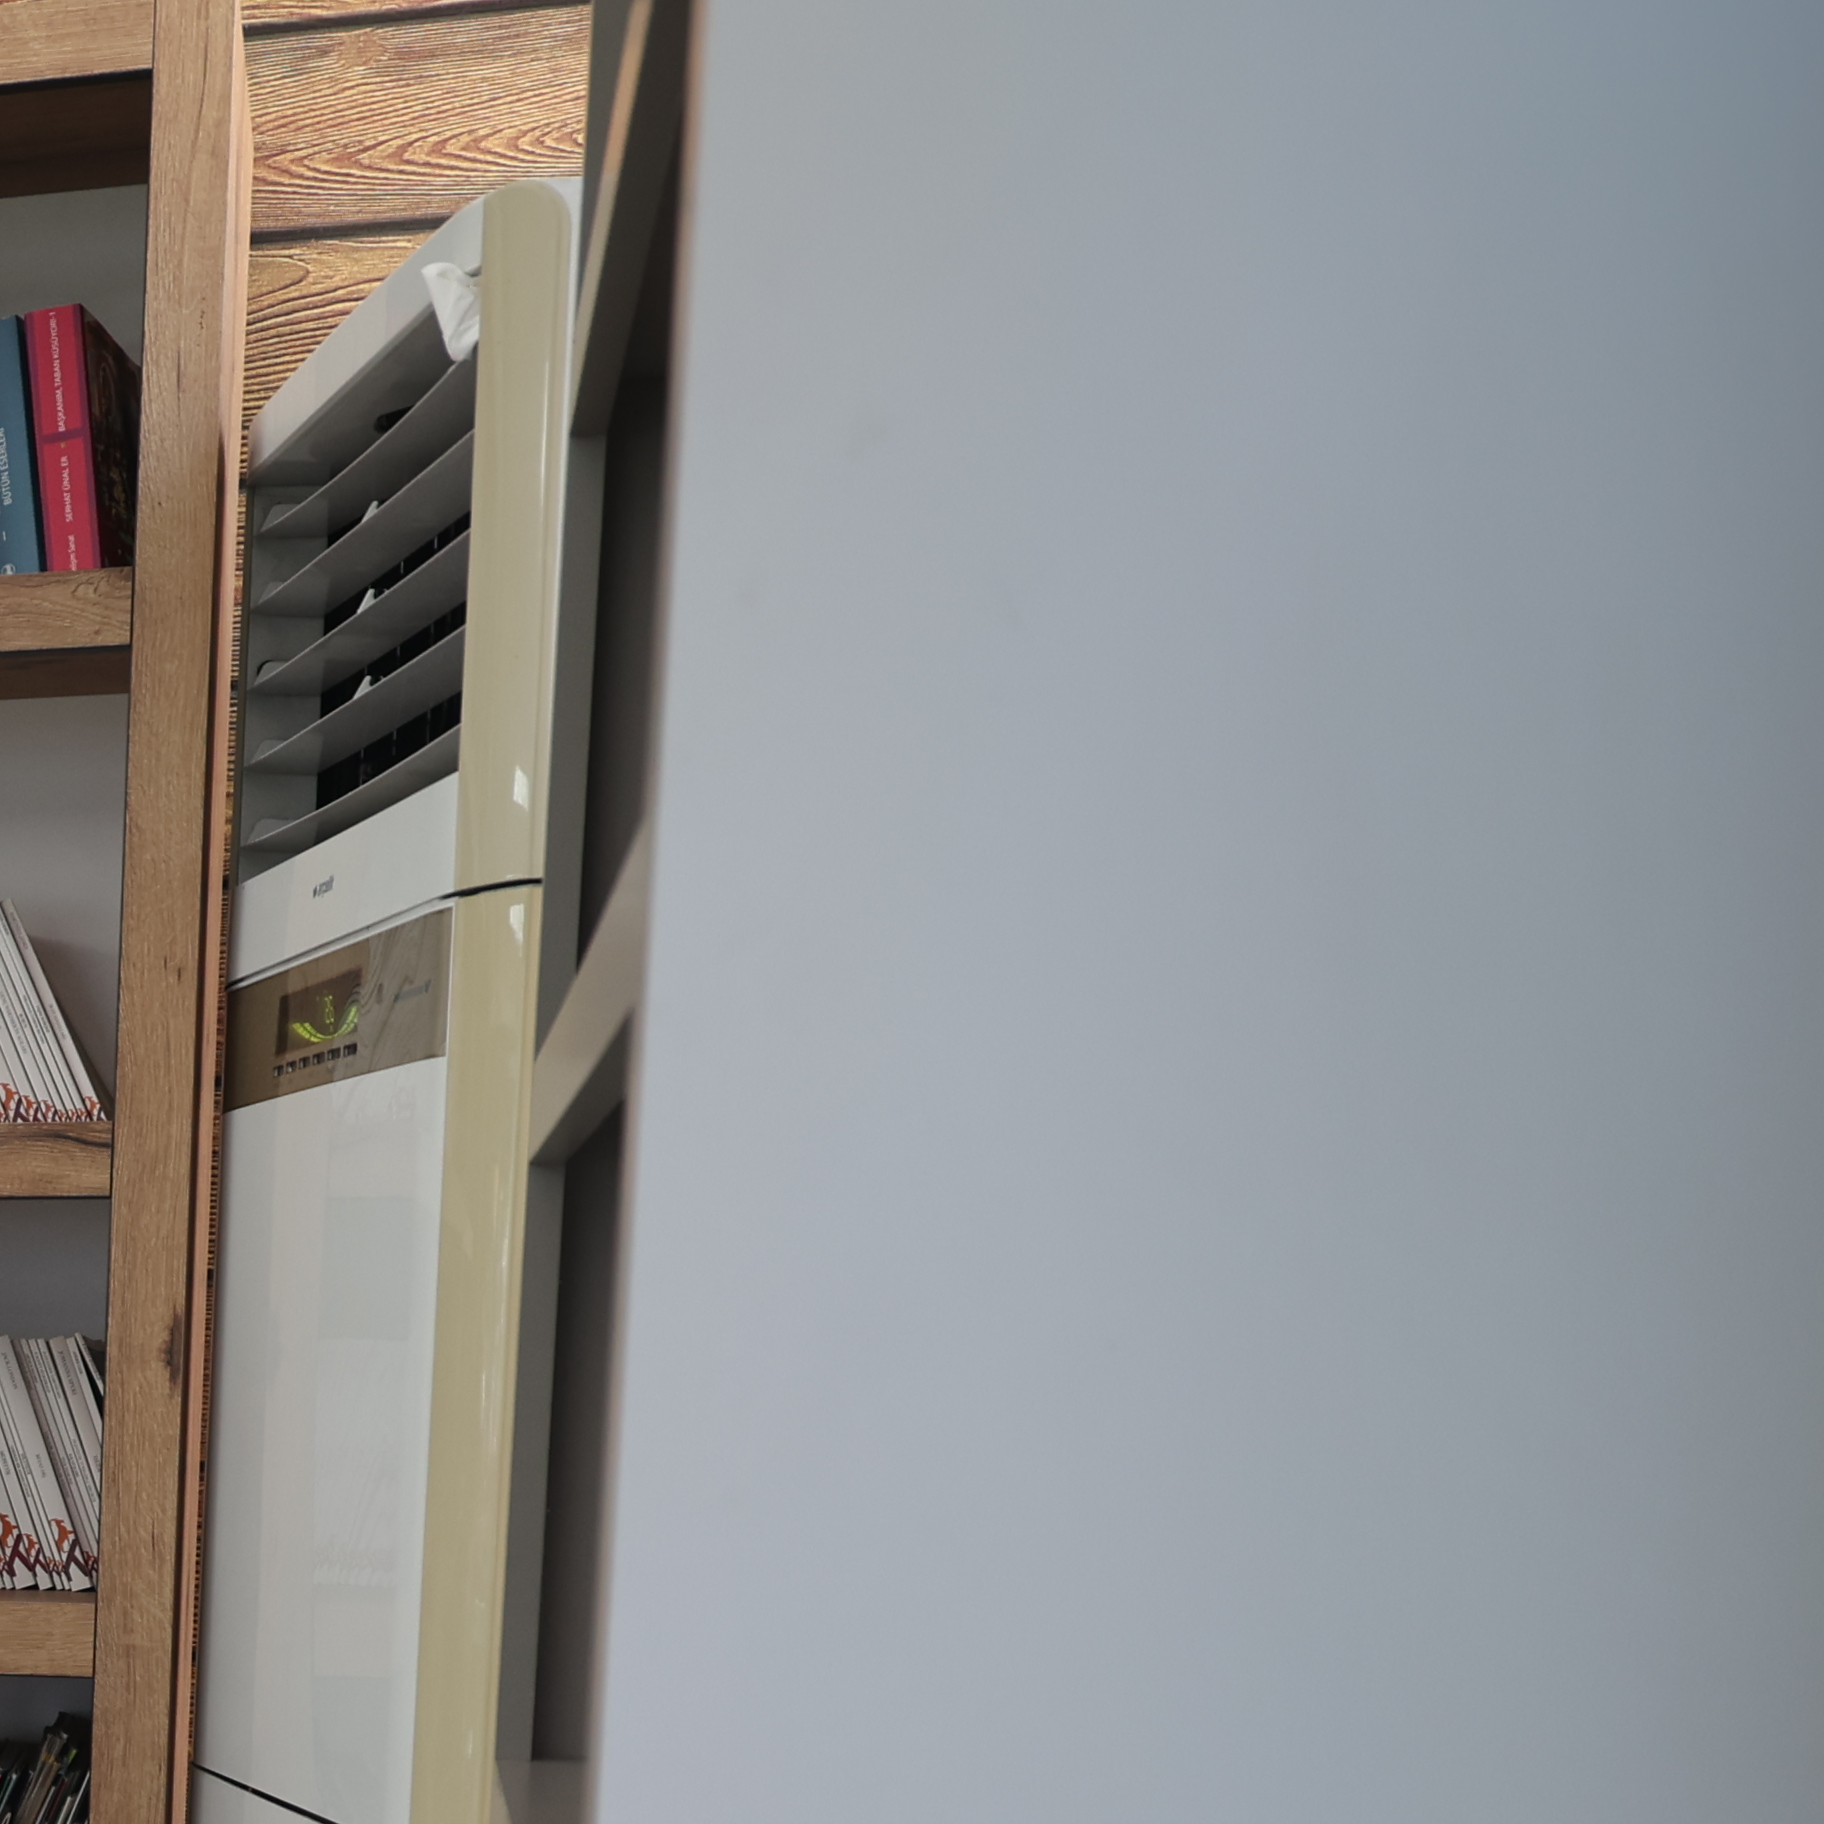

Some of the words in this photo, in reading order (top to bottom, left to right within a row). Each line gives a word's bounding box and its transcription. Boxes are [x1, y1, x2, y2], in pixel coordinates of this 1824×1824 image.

[52, 360, 63, 387] TABAN
[60, 456, 70, 467] ER
[0, 471, 13, 506] BÜTÜN
[61, 469, 72, 491] ÜNAL
[63, 492, 74, 522] SERHAT
